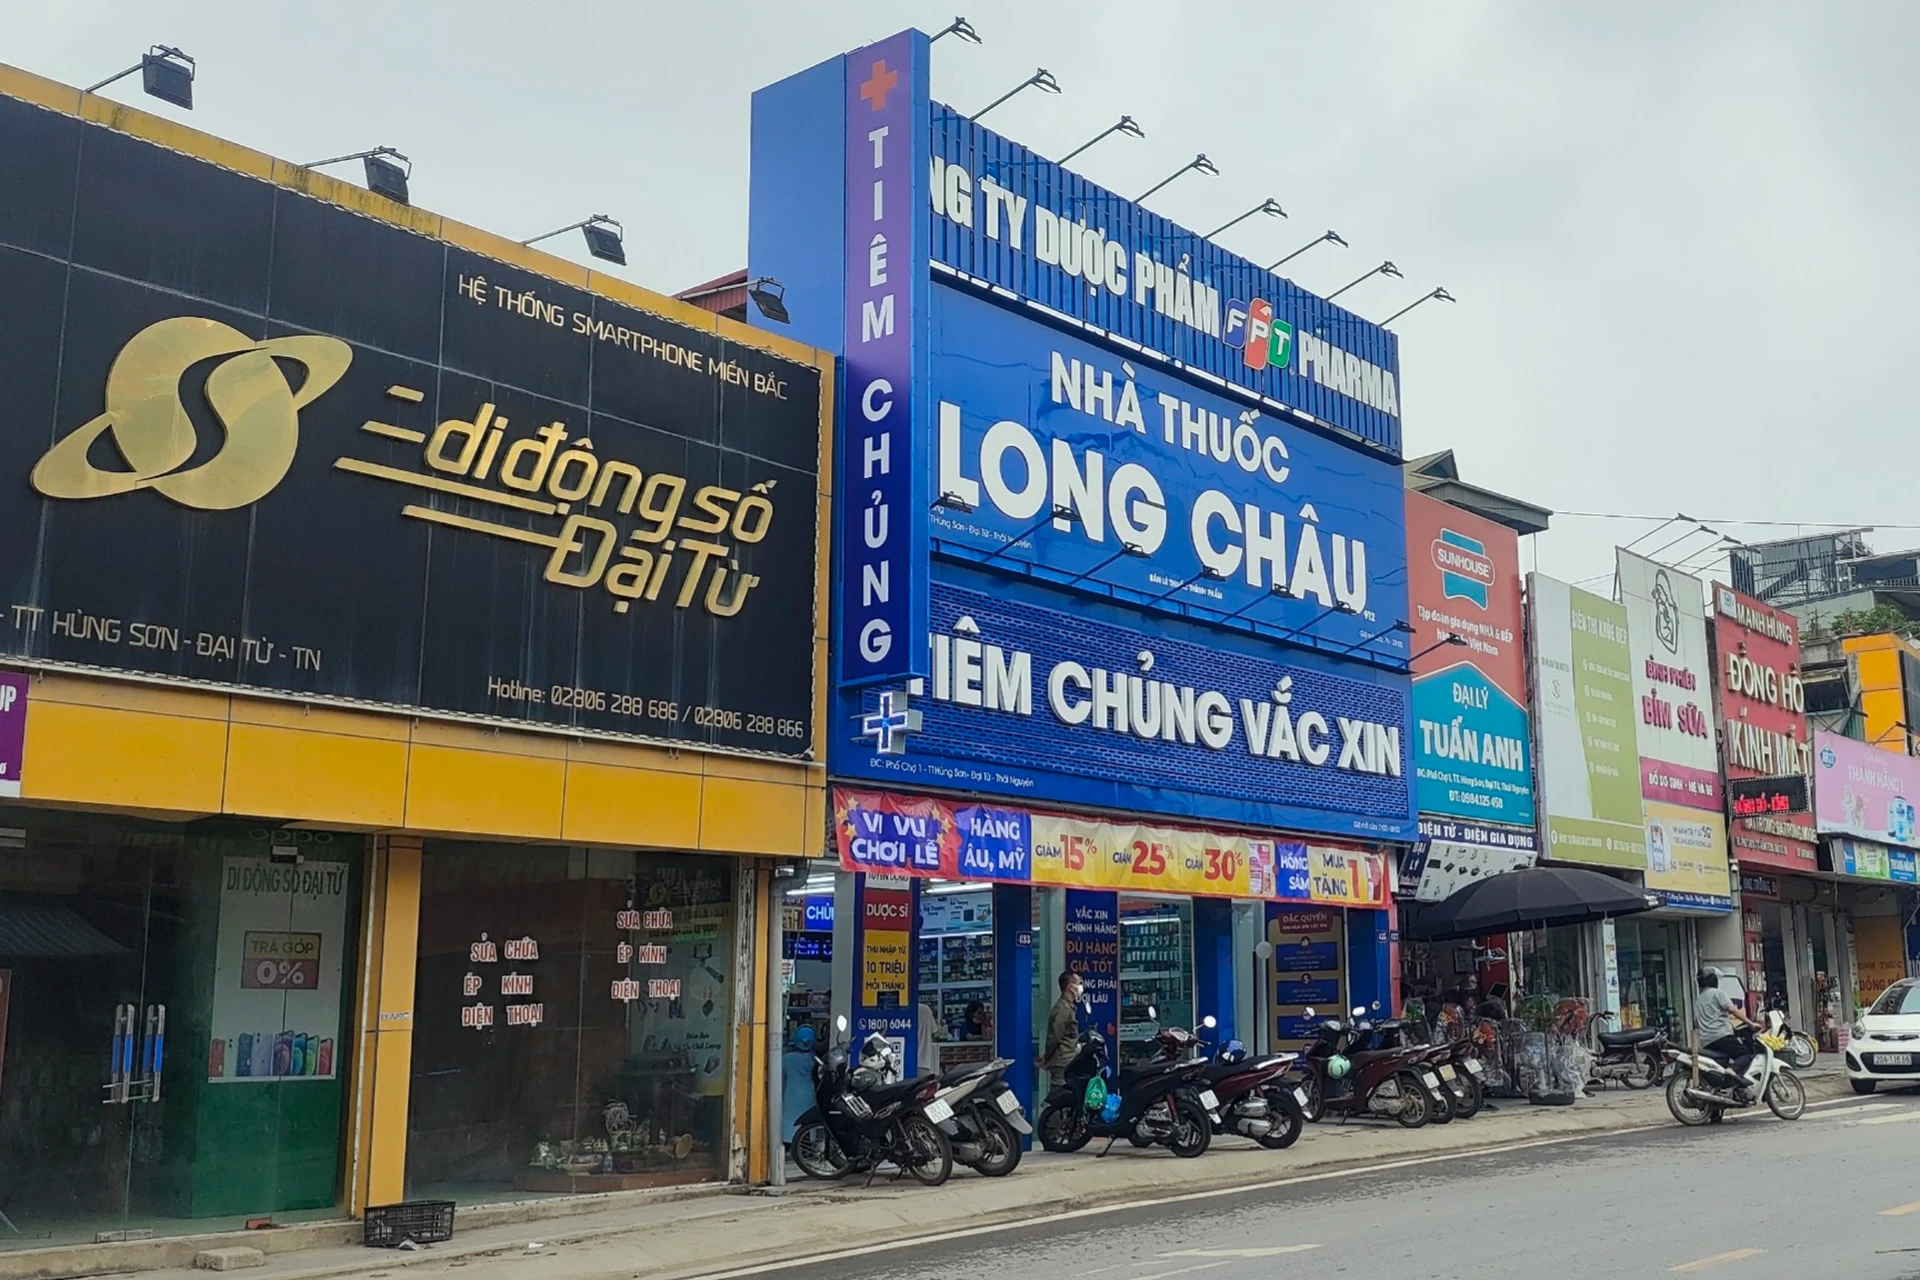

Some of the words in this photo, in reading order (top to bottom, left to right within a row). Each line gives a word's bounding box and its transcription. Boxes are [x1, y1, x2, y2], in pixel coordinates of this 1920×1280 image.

[861, 125, 895, 343] TIÊM
[930, 155, 971, 228] NG
[980, 177, 1028, 250] TY
[1035, 204, 1128, 297] DƯỢC
[1135, 251, 1220, 339] PHẨM
[1225, 303, 1291, 362] FPT
[1298, 329, 1399, 418] PHARMA
[458, 273, 487, 305] HỆ
[494, 286, 564, 327] THỐNG
[572, 313, 703, 372] SMARTPHONE
[708, 357, 749, 388] MIỀN
[753, 370, 788, 401] BẮC
[1051, 351, 1146, 434] NHÀ
[1158, 391, 1290, 484] THUỐC
[424, 402, 509, 480] di
[500, 420, 687, 544] động
[676, 478, 778, 544] số
[938, 400, 1168, 556] LONG
[1190, 489, 1368, 614] CHÂU
[543, 513, 675, 614] Đại
[675, 537, 760, 617] Từ
[1437, 548, 1490, 578] SUNHOUSE
[1417, 605, 1430, 621] Tập
[1431, 610, 1448, 625] đoàn
[1449, 614, 1460, 629] gia
[1460, 618, 1479, 636] dụng
[1736, 602, 1764, 635] MẠNH
[1766, 610, 1792, 646] HÙNG
[11, 605, 44, 631] TT
[52, 608, 121, 643] HÙNG
[129, 622, 178, 652] SƠN
[196, 631, 235, 663] ĐẠI
[242, 635, 275, 665] TỪ
[292, 646, 321, 671] TN
[1482, 641, 1499, 656] Nam
[1725, 641, 1778, 705] ĐỒNG
[1778, 661, 1804, 713] HỒ
[487, 675, 546, 704] Hotline:
[551, 685, 606, 712] 02806
[610, 693, 643, 717] 288
[648, 700, 678, 721] 686
[694, 706, 742, 731] 02806
[747, 714, 774, 735] 288
[777, 717, 804, 739] 866
[1452, 681, 1474, 710] ĐẠI
[1475, 685, 1489, 710] LÝ
[1047, 650, 1234, 750] CHỦNG
[1238, 674, 1331, 766] VẮC
[1336, 716, 1401, 777] XIN
[1642, 687, 1672, 730] BỈM
[1677, 701, 1708, 739] SỮA
[1419, 715, 1479, 763] TUẤN
[1481, 732, 1524, 772] ANH
[1727, 706, 1774, 775] KÍNH
[1774, 723, 1811, 777] MẮT
[870, 758, 884, 769] ĐC:
[885, 759, 900, 770] Phố
[901, 761, 917, 774] Chợ
[996, 773, 1009, 783] Thái
[1009, 775, 1034, 787] Nguyên
[1848, 764, 1877, 787] THANH
[862, 812, 883, 834] VI
[893, 815, 926, 838] VU
[970, 814, 1021, 841] HÀNG
[1443, 823, 1456, 838] TỬ
[1464, 827, 1487, 844] ĐIỆN
[1490, 831, 1507, 845] GIA
[1508, 834, 1533, 848] DỤNG
[851, 838, 907, 864] CHƠI
[914, 837, 939, 866] LỄ
[964, 841, 994, 872] ÂU,
[998, 846, 1025, 871] MỸ
[1280, 852, 1309, 870] HỒNG
[1322, 853, 1346, 870] MUA
[226, 866, 240, 891] DI
[242, 862, 281, 897] ĐỘNG
[302, 869, 324, 900] ĐẠI
[327, 864, 348, 896] TỪ
[1288, 874, 1310, 891] SÂM
[1313, 873, 1348, 899] TẶNG
[616, 900, 640, 930] SỬA
[866, 903, 898, 920] DƯỢC
[899, 903, 909, 918] SĨ
[1094, 909, 1108, 920] XIN
[1066, 921, 1092, 933] CHÍNH
[282, 938, 314, 955] GÓP
[470, 932, 498, 962] SỬA
[504, 936, 539, 960] CHỮA
[617, 941, 633, 964] ÉP
[638, 941, 667, 965] KÍNH
[866, 945, 878, 954] THU
[1085, 938, 1118, 955] HÀNG
[256, 958, 304, 985] 0%
[866, 961, 877, 974] 10
[879, 959, 906, 977] TRIỆU
[1070, 956, 1090, 973] GIÁ
[1092, 955, 1114, 973] TỐT
[463, 972, 482, 996] ÉP
[501, 971, 533, 995] KÍNH
[611, 977, 640, 1003] ĐIỆN
[648, 978, 681, 1001] THOẠI
[881, 979, 906, 991] THÁNG
[461, 1002, 494, 1030] ĐIỆN
[506, 1003, 544, 1027] THOẠI
[889, 1018, 912, 1030] 6044
